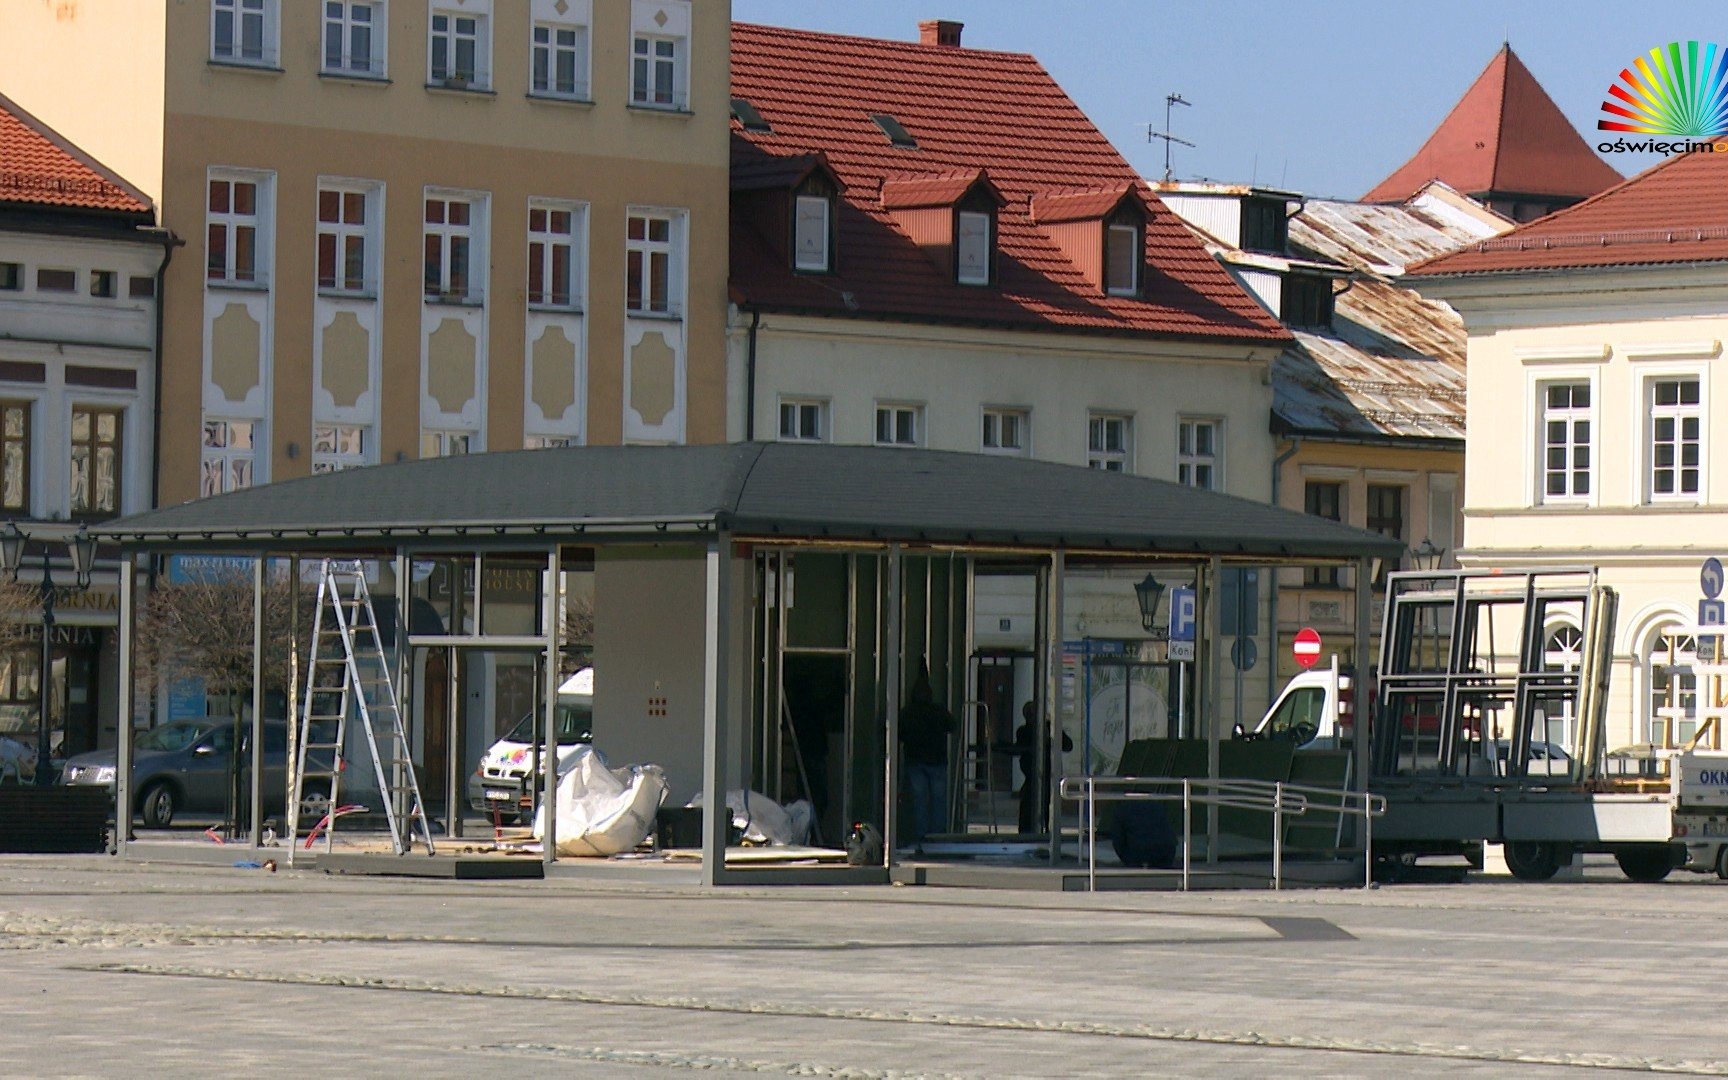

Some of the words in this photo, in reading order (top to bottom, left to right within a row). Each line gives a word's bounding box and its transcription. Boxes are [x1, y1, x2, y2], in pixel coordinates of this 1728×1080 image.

[179, 557, 257, 569] max-ELEKTR
[1179, 595, 1195, 633] P
[1700, 769, 1728, 785] OKN
